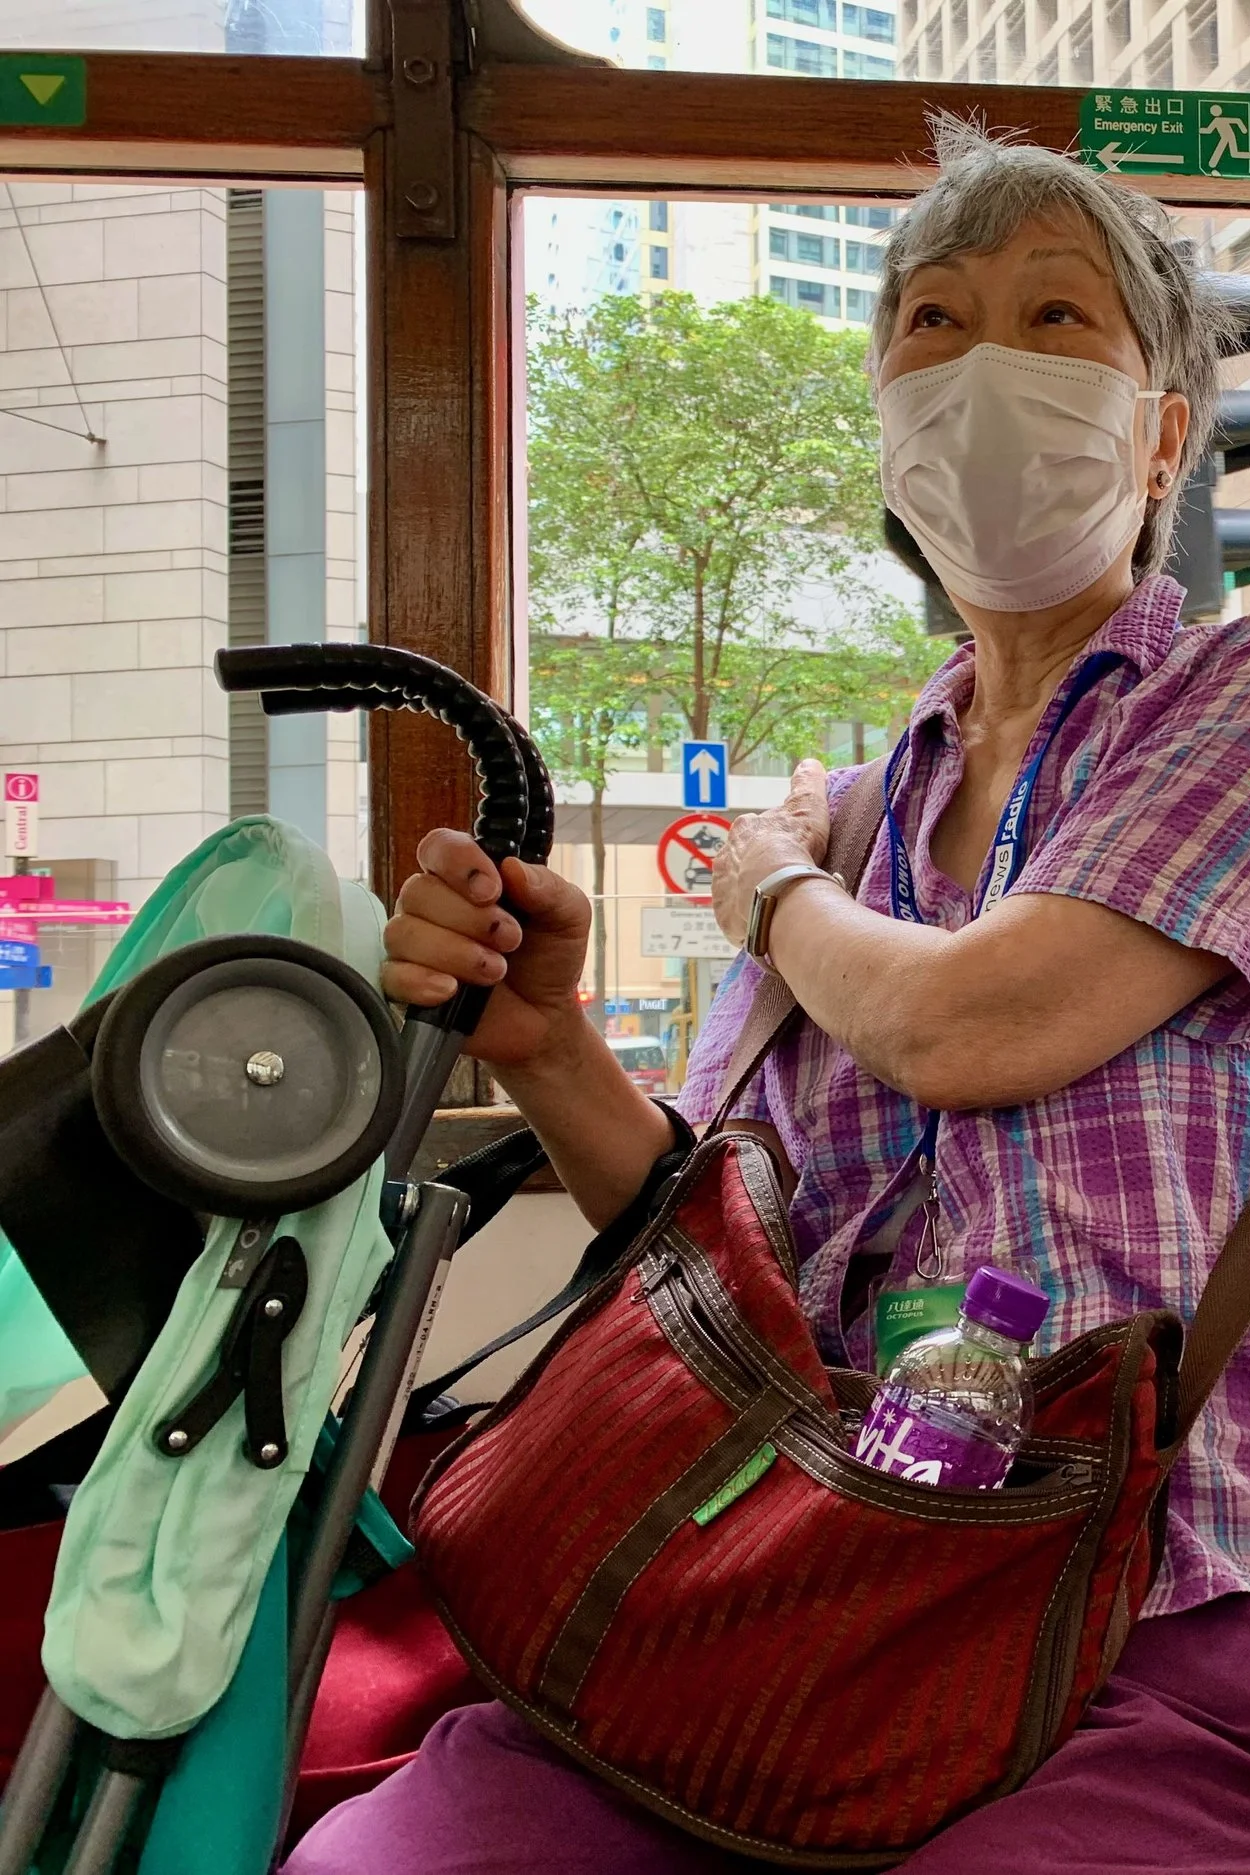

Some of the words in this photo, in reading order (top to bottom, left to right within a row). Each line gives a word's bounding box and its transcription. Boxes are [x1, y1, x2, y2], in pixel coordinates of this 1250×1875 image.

[1095, 94, 1184, 115] 緊急出口
[1094, 118, 1157, 134] Emergency
[1162, 120, 1184, 134] Exit
[1001, 780, 1029, 841] radio
[14, 806, 27, 850] Central
[984, 849, 1010, 912] news
[639, 999, 667, 1011] PIAGET
[887, 1298, 925, 1313] 八達通
[886, 1311, 924, 1320] OCTOPUS
